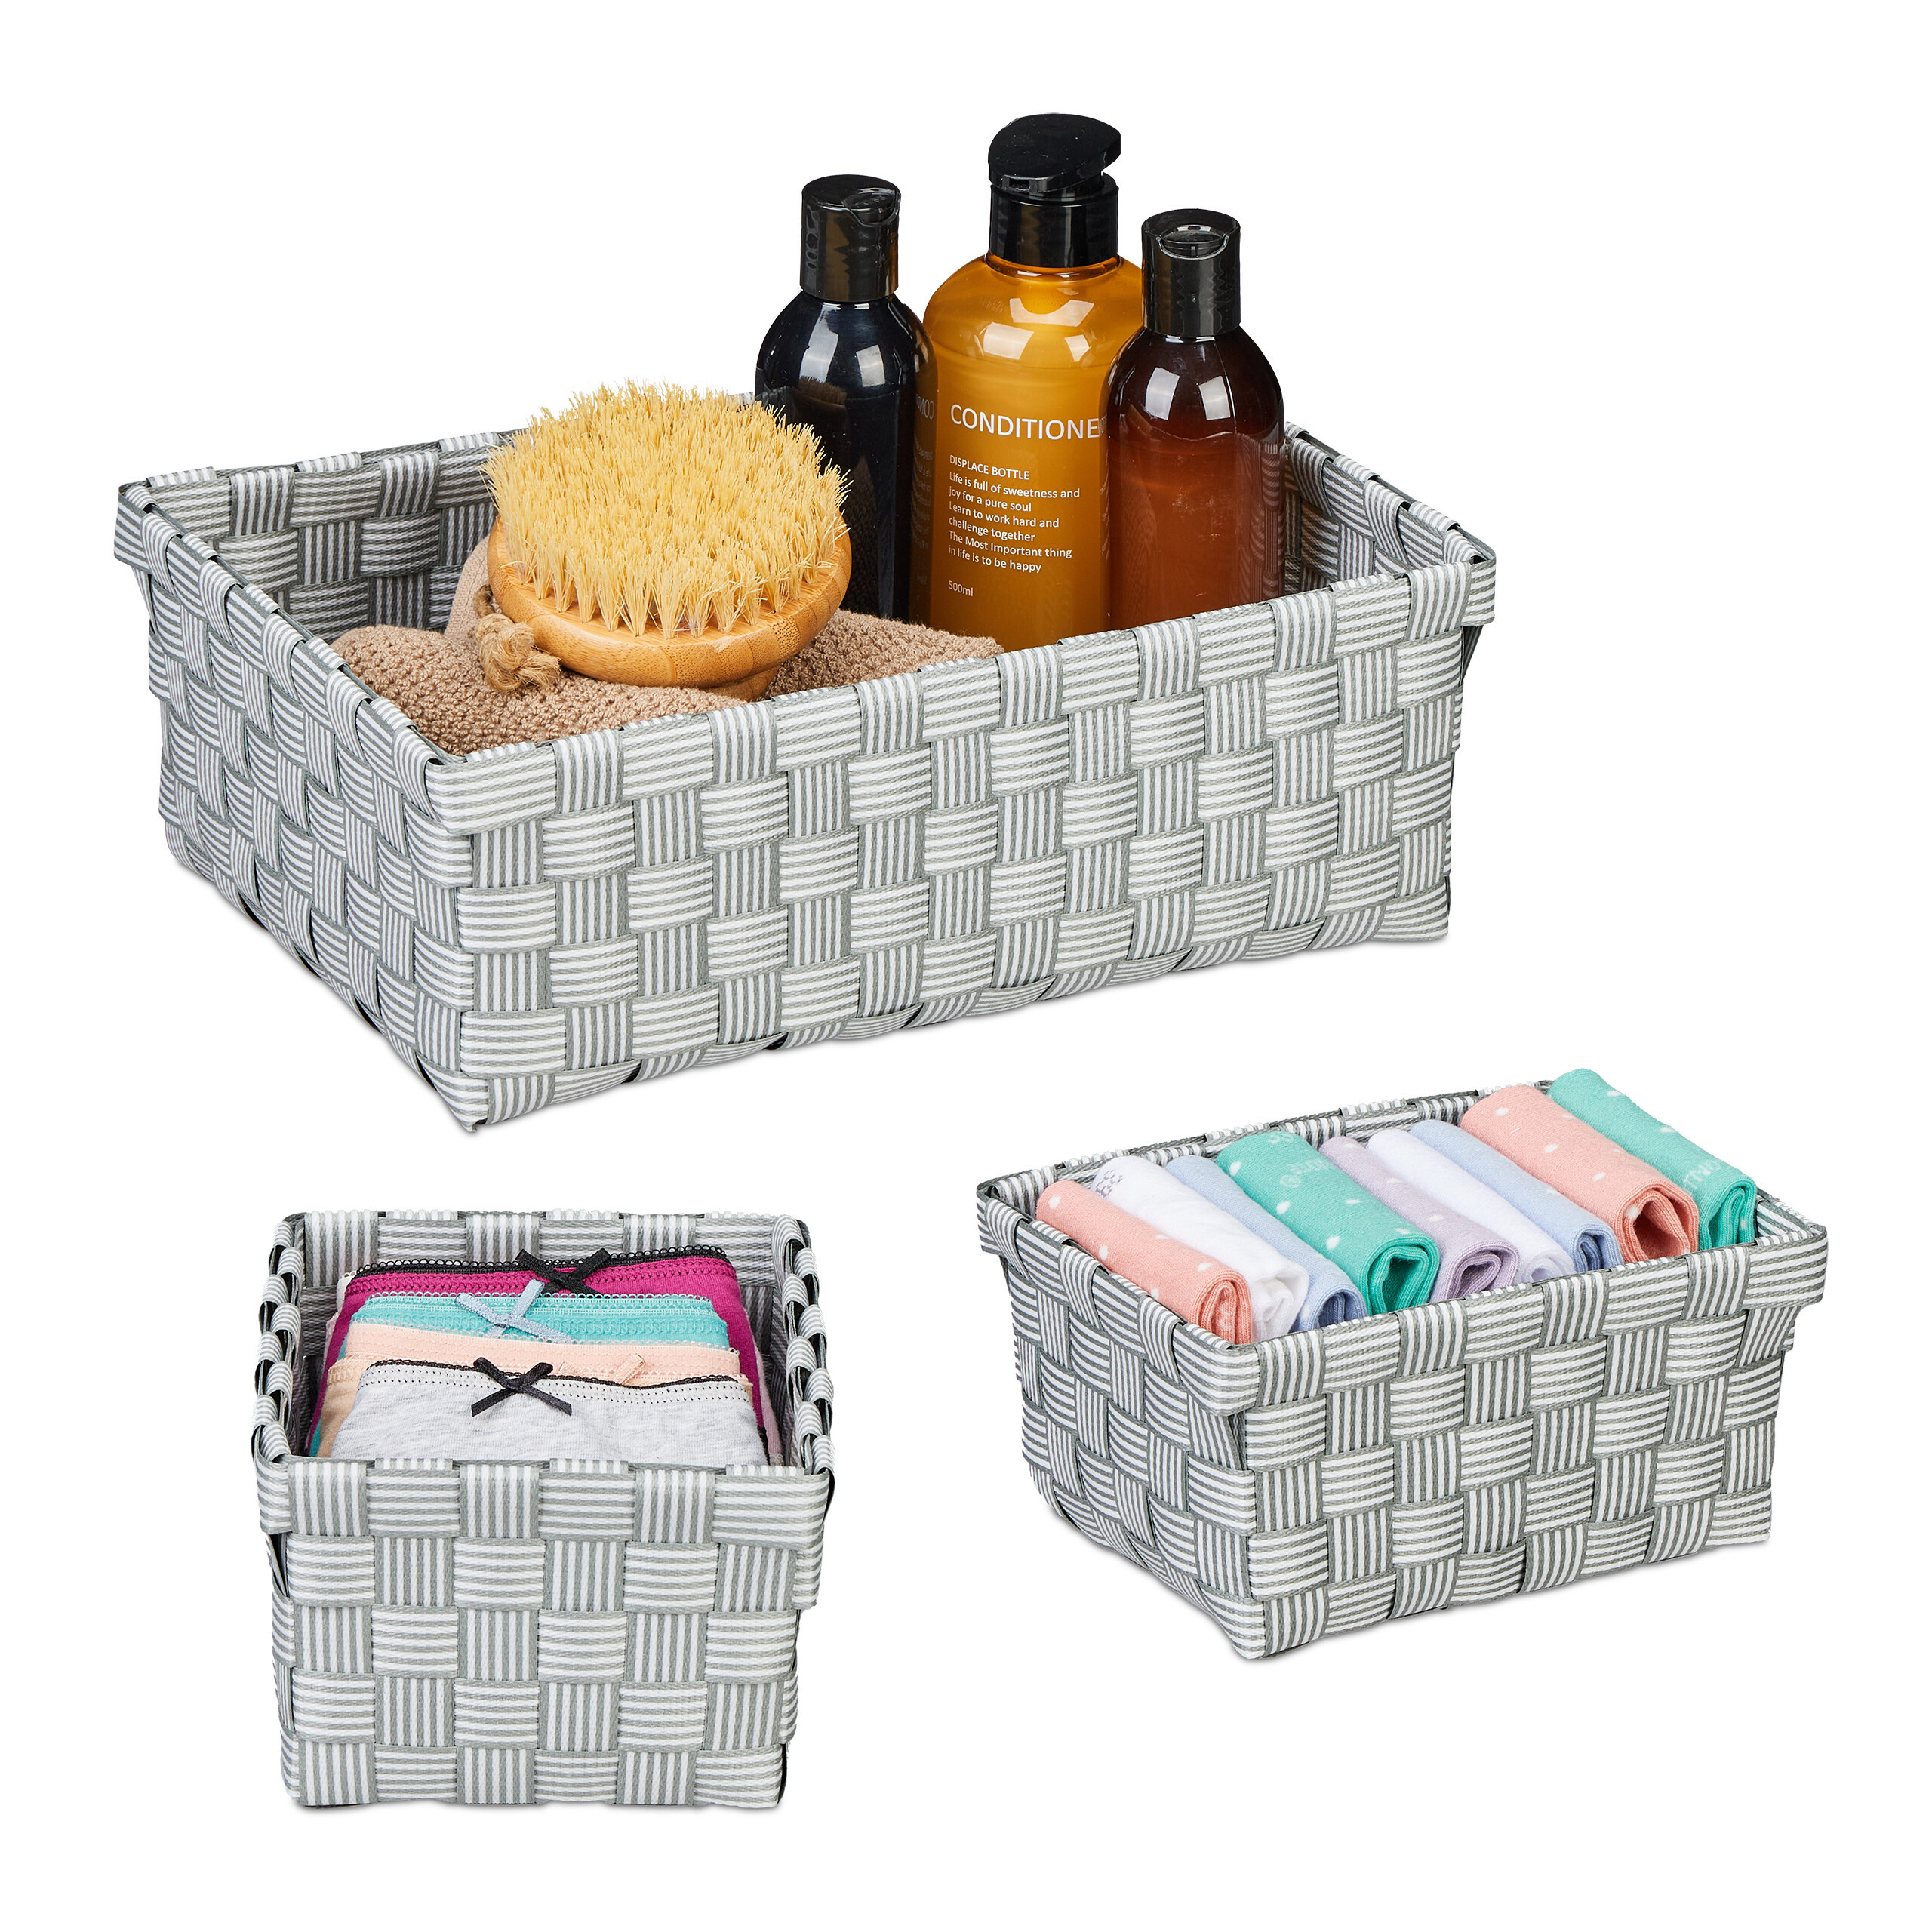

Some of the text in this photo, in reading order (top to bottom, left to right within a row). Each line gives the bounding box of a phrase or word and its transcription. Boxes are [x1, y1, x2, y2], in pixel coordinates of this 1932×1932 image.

[950, 404, 1100, 440] CONDITIONE
[949, 454, 989, 475] DISPLACE
[992, 466, 1030, 480] BOTTLE
[949, 472, 1080, 498] Life is full of sweetness and
[949, 485, 1032, 512] joy for a pure soul
[949, 500, 1059, 528] Learn to work hard and
[949, 516, 989, 537] challenge
[991, 528, 1035, 542] together
[949, 530, 1072, 559] The Most Important thing
[949, 544, 1041, 574] in life is to be happy
[949, 580, 974, 597] 500ml
